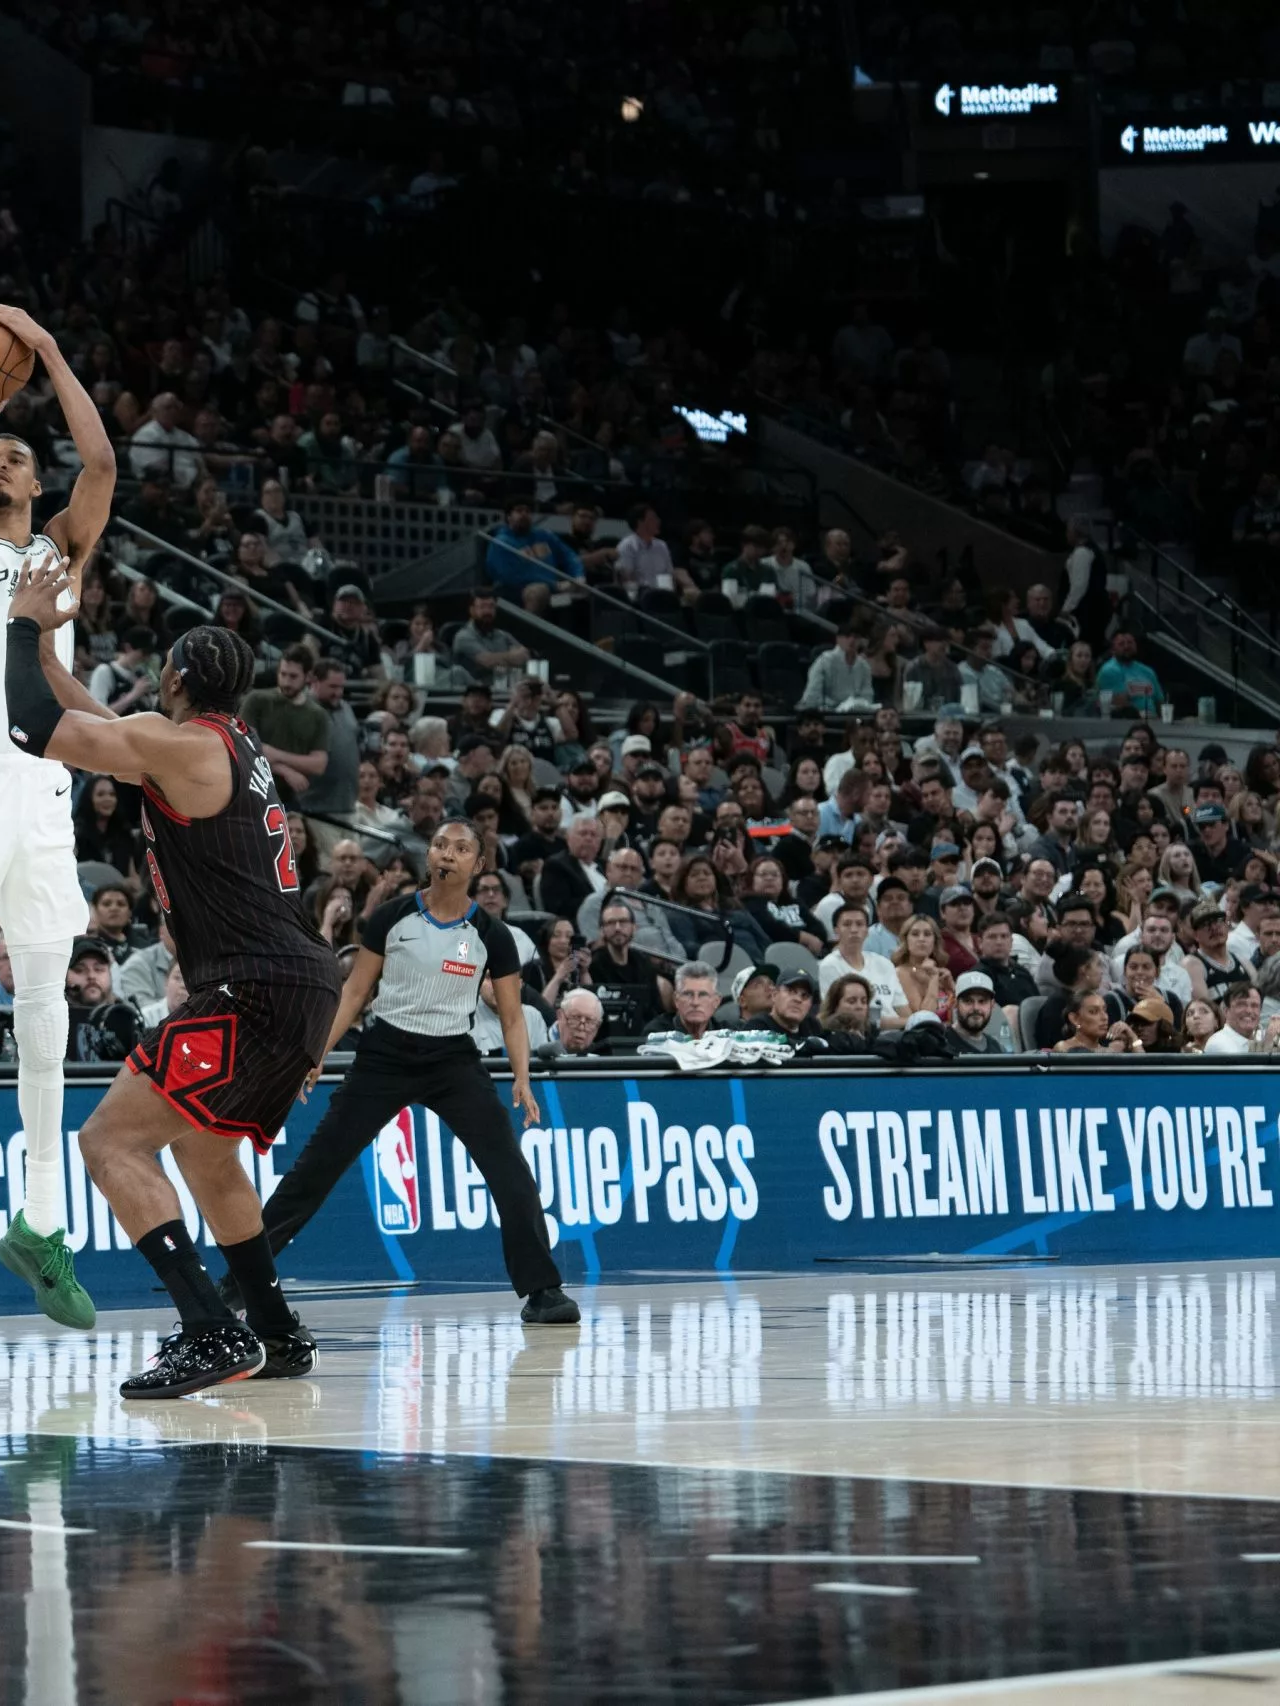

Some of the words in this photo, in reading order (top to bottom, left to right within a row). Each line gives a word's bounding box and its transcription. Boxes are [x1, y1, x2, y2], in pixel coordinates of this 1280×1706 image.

[961, 84, 1058, 104] Methodist
[1143, 125, 1227, 143] Methodist
[443, 961, 475, 975] Emirates
[626, 1100, 760, 1224] Pass
[818, 1109, 1010, 1222] STREAM
[1014, 1107, 1117, 1215] LIKE
[1117, 1105, 1275, 1212] YOU'RE
[383, 1203, 406, 1226] NBA
